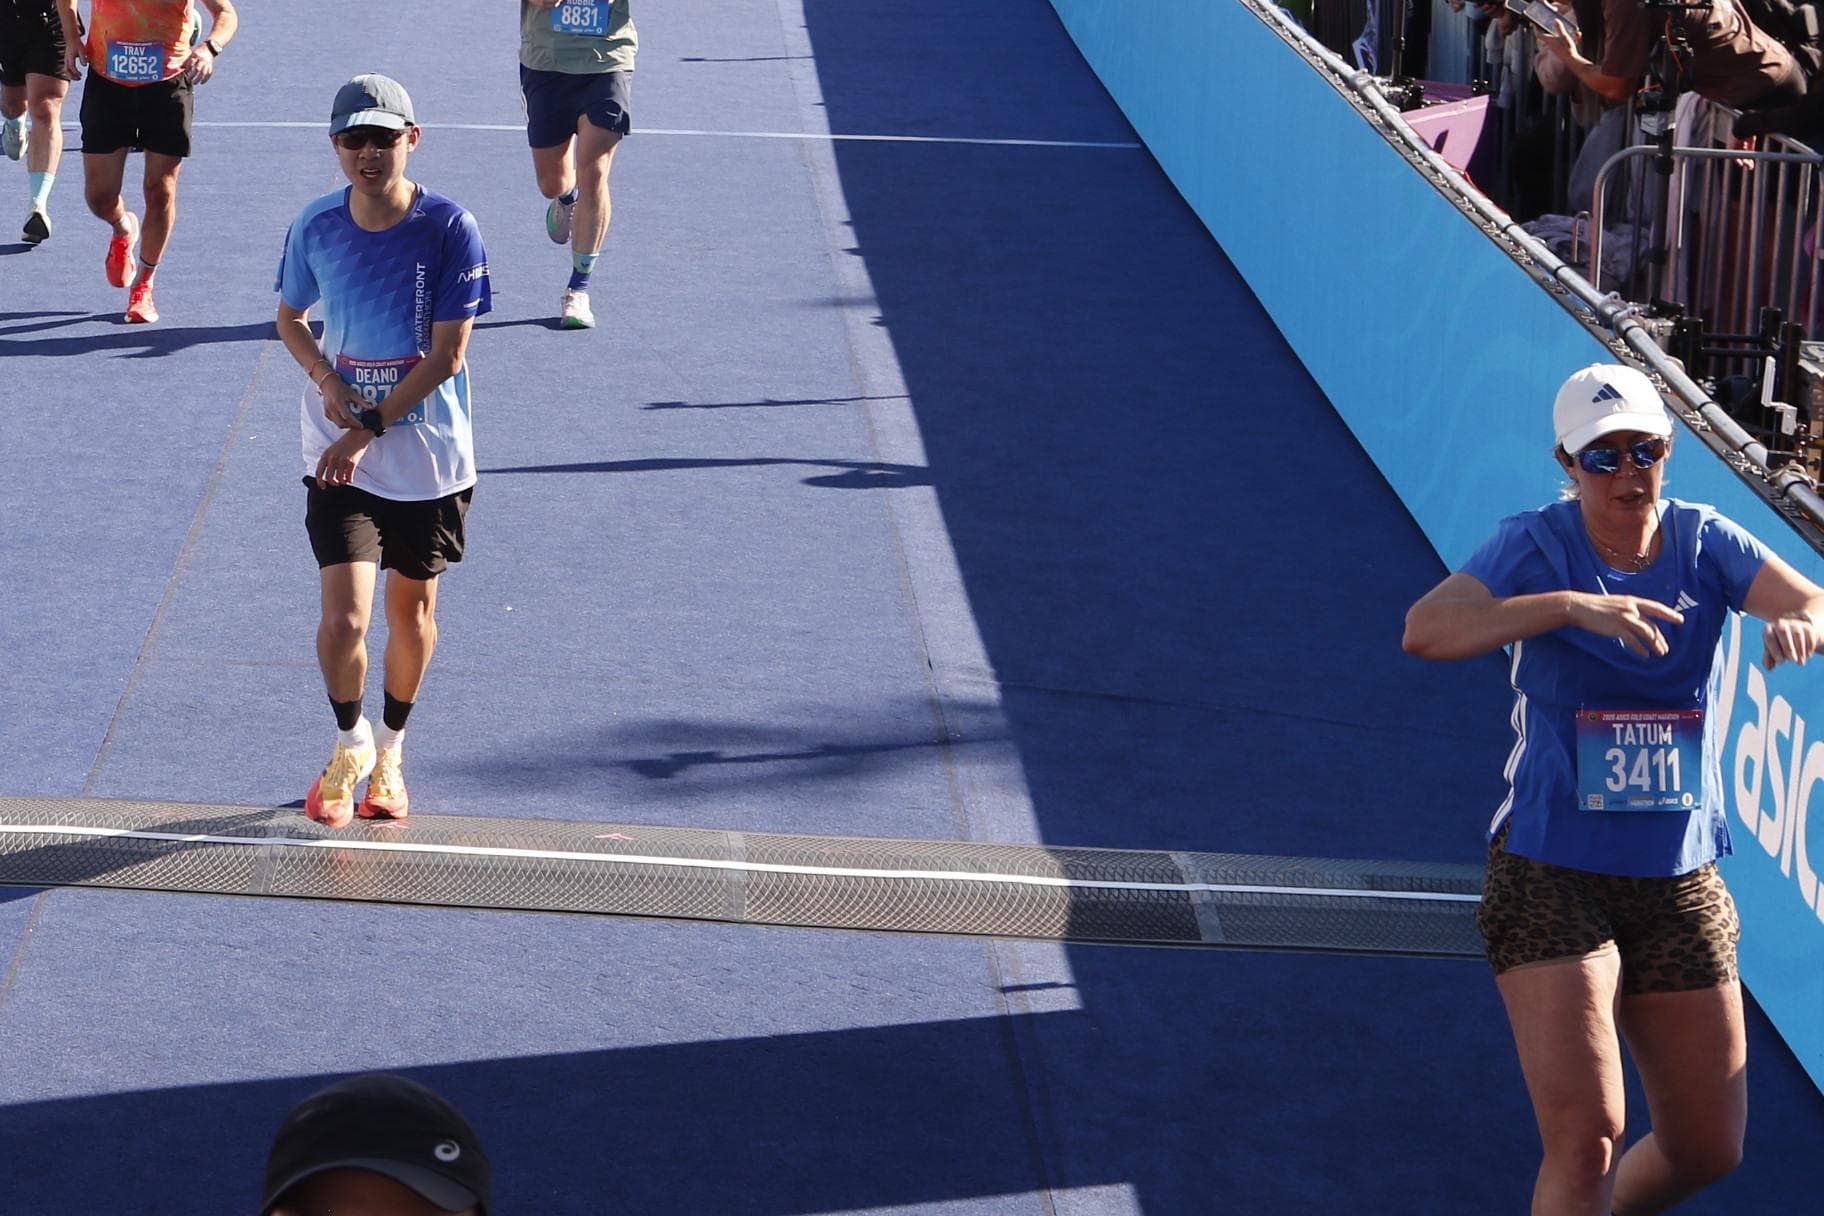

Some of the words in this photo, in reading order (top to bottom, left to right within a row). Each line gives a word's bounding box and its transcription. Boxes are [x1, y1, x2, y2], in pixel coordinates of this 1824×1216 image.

[560, 6, 598, 28] 8831
[123, 45, 146, 56] TRAV
[111, 55, 158, 75] 12652
[415, 261, 427, 345] WATERFRONT
[355, 367, 398, 384] DEANO
[1611, 722, 1673, 746] TATUM
[1604, 747, 1681, 793] 3411
